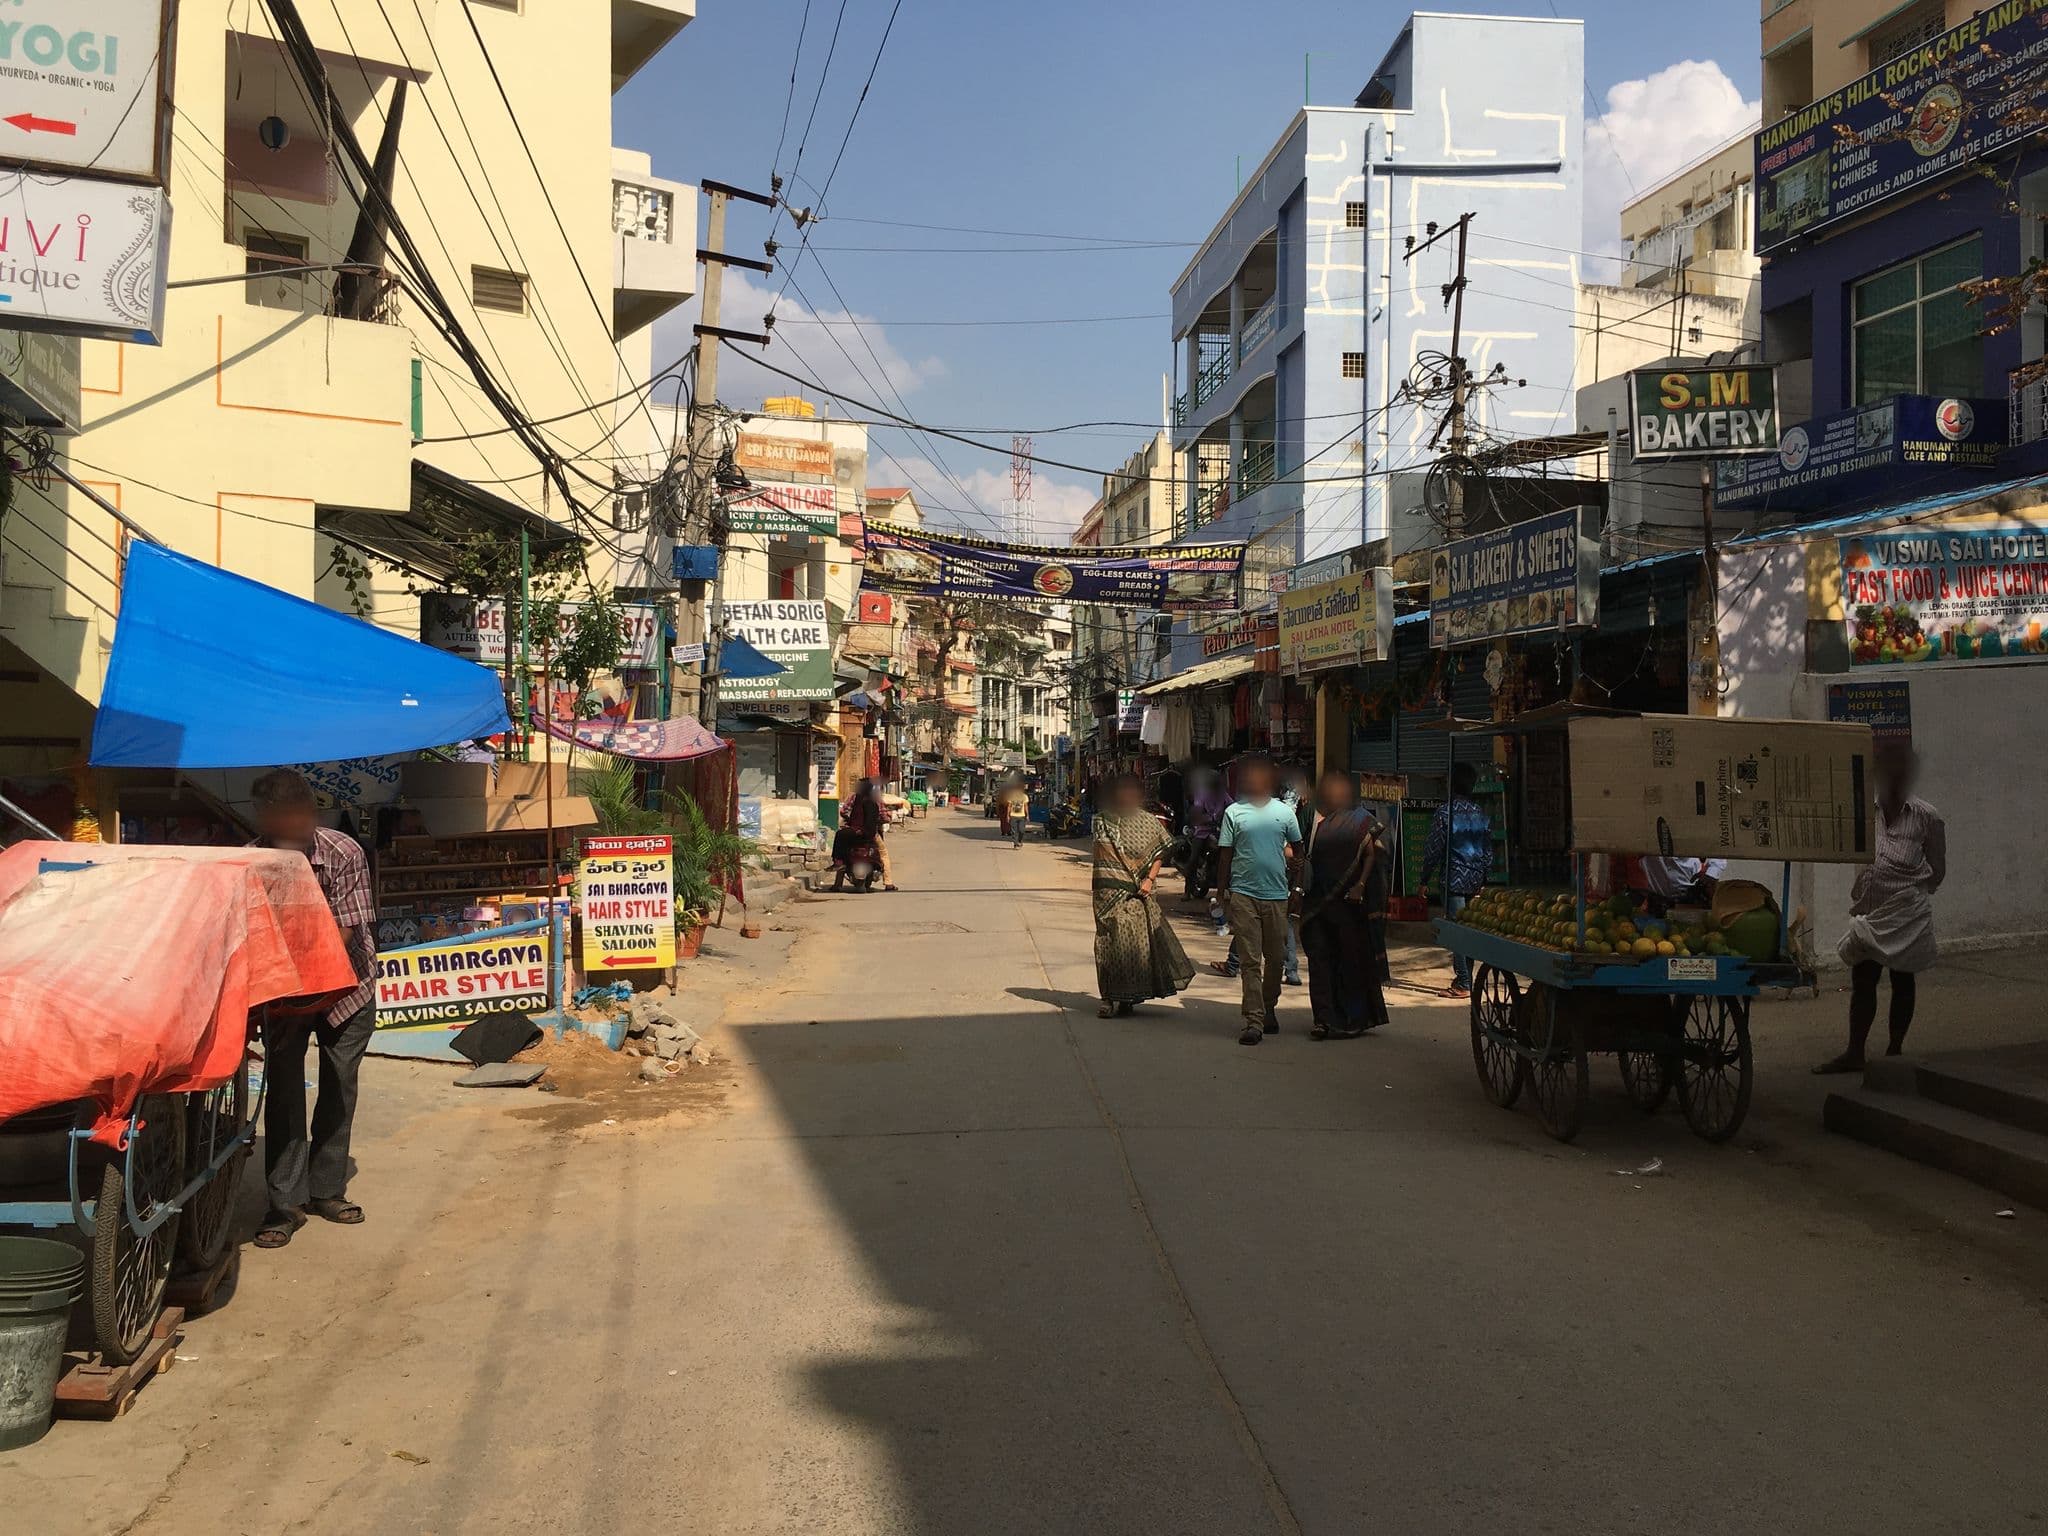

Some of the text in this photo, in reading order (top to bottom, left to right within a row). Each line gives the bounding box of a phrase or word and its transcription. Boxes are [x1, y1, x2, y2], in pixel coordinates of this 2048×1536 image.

[0, 20, 119, 76] YOGI
[48, 73, 85, 89] ORGANIC
[93, 79, 116, 93] YOGA
[1761, 0, 2024, 154] HANUMAN'S HILL ROCK CAFE AND
[1840, 145, 1870, 172] INDIAN
[1836, 129, 2002, 214] MOCKTAILS AND HOME MADE ICE
[1839, 160, 1878, 189] CHINESE
[1640, 408, 1772, 450] BAKERY
[745, 442, 763, 457] SRI
[766, 445, 784, 459] SAI
[785, 446, 830, 464] VIJAYAM
[1903, 440, 1981, 453] HANUMAN'S HILL
[1904, 451, 1925, 461] CAFE
[1927, 452, 1947, 462] AND
[1717, 450, 1893, 503] HANUMAN'S HILL ROCK CAFE AND RESTAURANT
[805, 488, 834, 511] CARE
[764, 523, 809, 532] MASSAGE
[866, 520, 1242, 560] HANUMAN'S HILL ROCK CAFE AND RESTAURANT
[867, 533, 898, 546] FREE
[1473, 541, 1514, 588] BAKERY
[1517, 538, 1525, 579] &
[1528, 524, 1575, 576] SWEETS
[1876, 538, 1945, 565] VISWA
[1950, 537, 1984, 561] SAI
[953, 557, 1020, 572] CONTINENTAL
[1150, 560, 1171, 569] FREE
[1172, 561, 1197, 570] HOME
[952, 576, 993, 588] CHINESE
[1082, 569, 1153, 580] EGG-LESS CAKES
[1119, 581, 1152, 590] BREADS
[1847, 569, 1888, 605] FAST
[1892, 567, 1935, 602] FOOD
[1939, 566, 1950, 599] &
[1955, 563, 1999, 599] JUICE
[951, 590, 1007, 602] MOCKTAILS
[1010, 595, 1034, 604] AND
[1037, 596, 1063, 605] HOME
[1100, 589, 1132, 598] COFFEE
[778, 604, 824, 620] SORIG
[1952, 610, 1969, 618] FRUIT
[1991, 608, 2014, 616] BUTTER
[444, 632, 504, 643] AUTHENTIC
[781, 628, 822, 644] CARE
[1291, 619, 1358, 644] SAI LATHA HOTEL
[719, 679, 781, 688] ASTROLOGY
[719, 688, 833, 700] MASSAGE REFLEXOLOGY
[1847, 689, 1906, 699] VISWA SAI
[729, 702, 790, 714] JEWELLERS
[1848, 701, 1886, 710] HOTEL
[1718, 758, 1730, 848] Washing Machine
[584, 838, 667, 851] సాయి భార్గవ
[588, 882, 668, 896] SAI BHARGAVA
[588, 899, 668, 919] HAIR STYLE
[594, 923, 654, 937] SHAVING
[602, 938, 657, 950] SALOON
[376, 944, 543, 979] SAI BHARGAVA
[380, 968, 545, 1002] HAIR STYLE
[375, 995, 547, 1027] SHAVING SALOON
